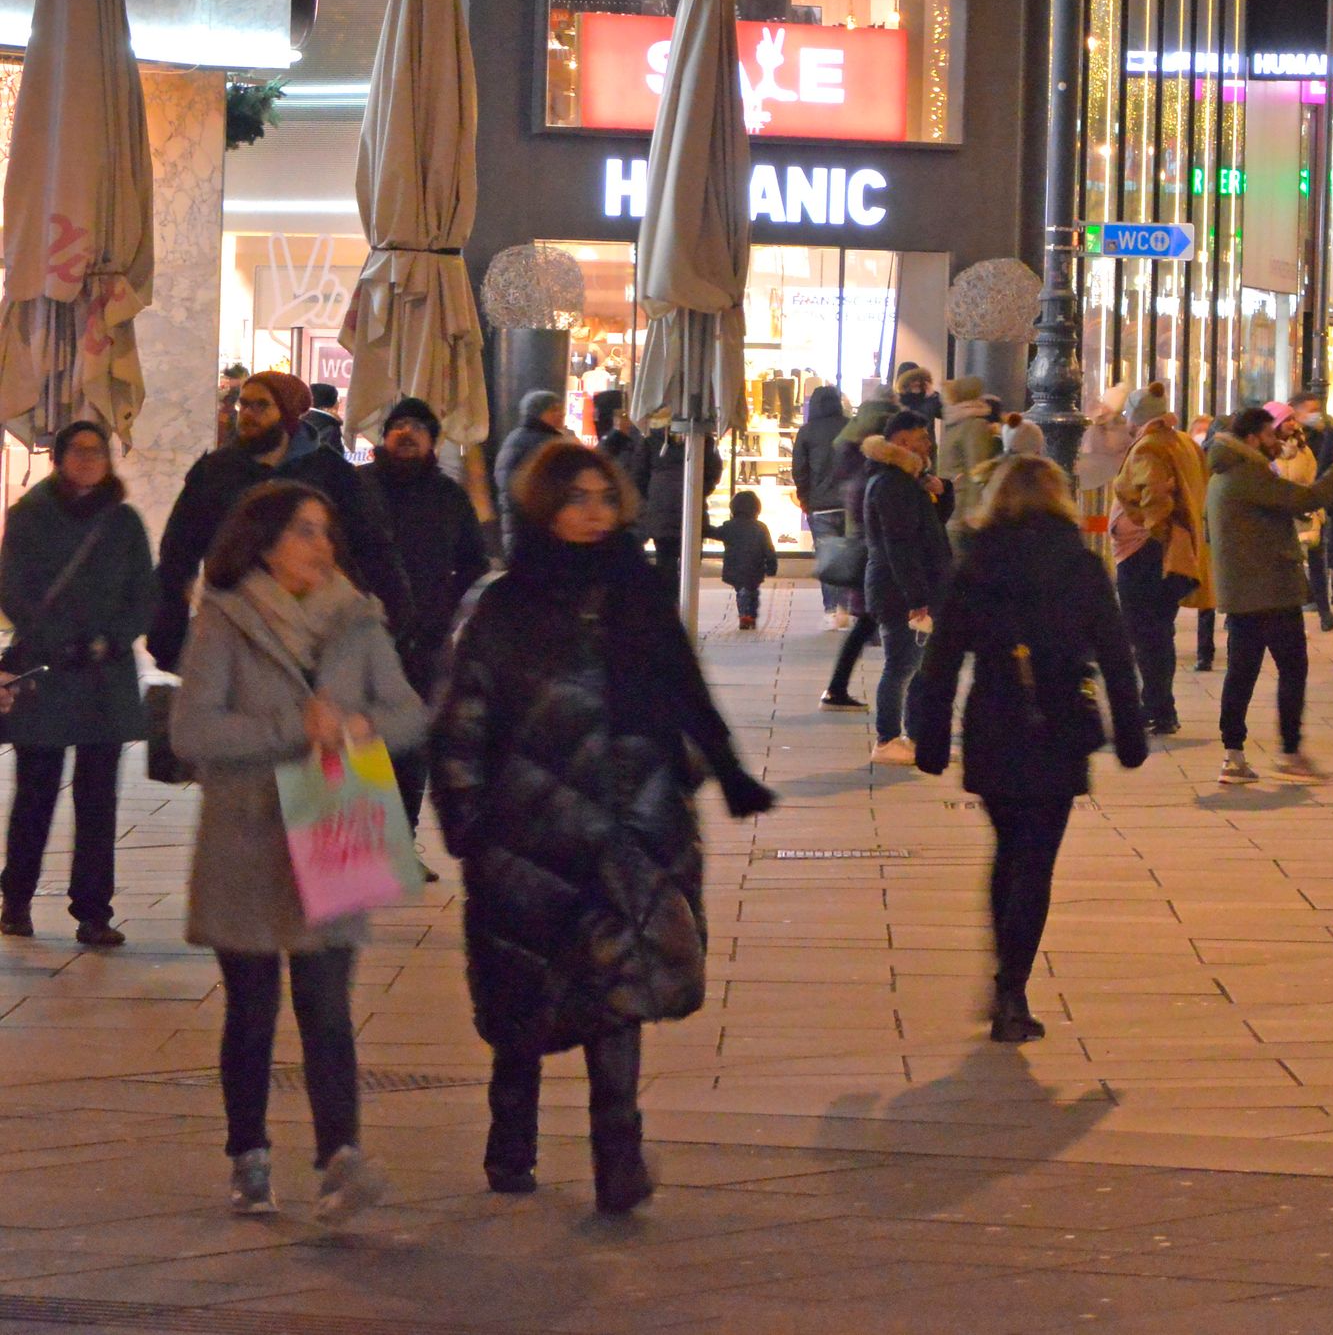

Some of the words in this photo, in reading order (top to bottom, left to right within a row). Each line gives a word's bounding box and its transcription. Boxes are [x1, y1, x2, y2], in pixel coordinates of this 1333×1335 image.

[645, 28, 845, 105] SLE
[604, 159, 888, 226] HANIC
[1118, 230, 1150, 250] WC
